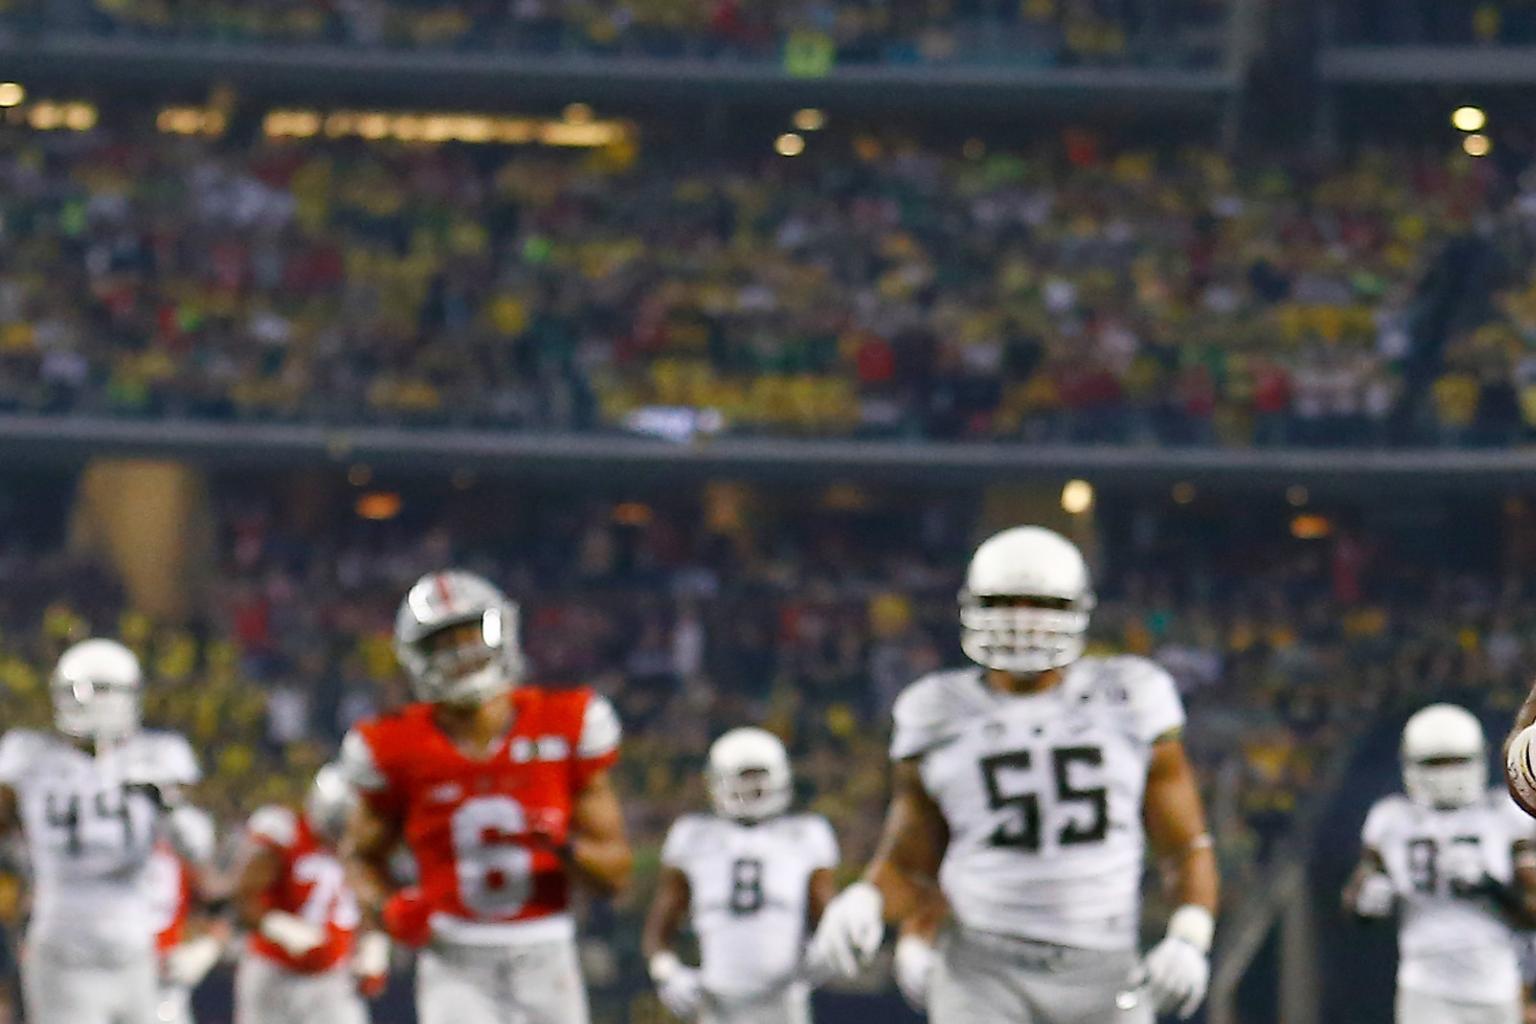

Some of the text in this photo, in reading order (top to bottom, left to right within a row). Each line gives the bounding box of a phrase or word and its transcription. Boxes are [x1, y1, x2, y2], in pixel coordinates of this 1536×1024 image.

[979, 747, 1107, 852] 55
[453, 795, 532, 919] 6
[730, 857, 764, 917] 8
